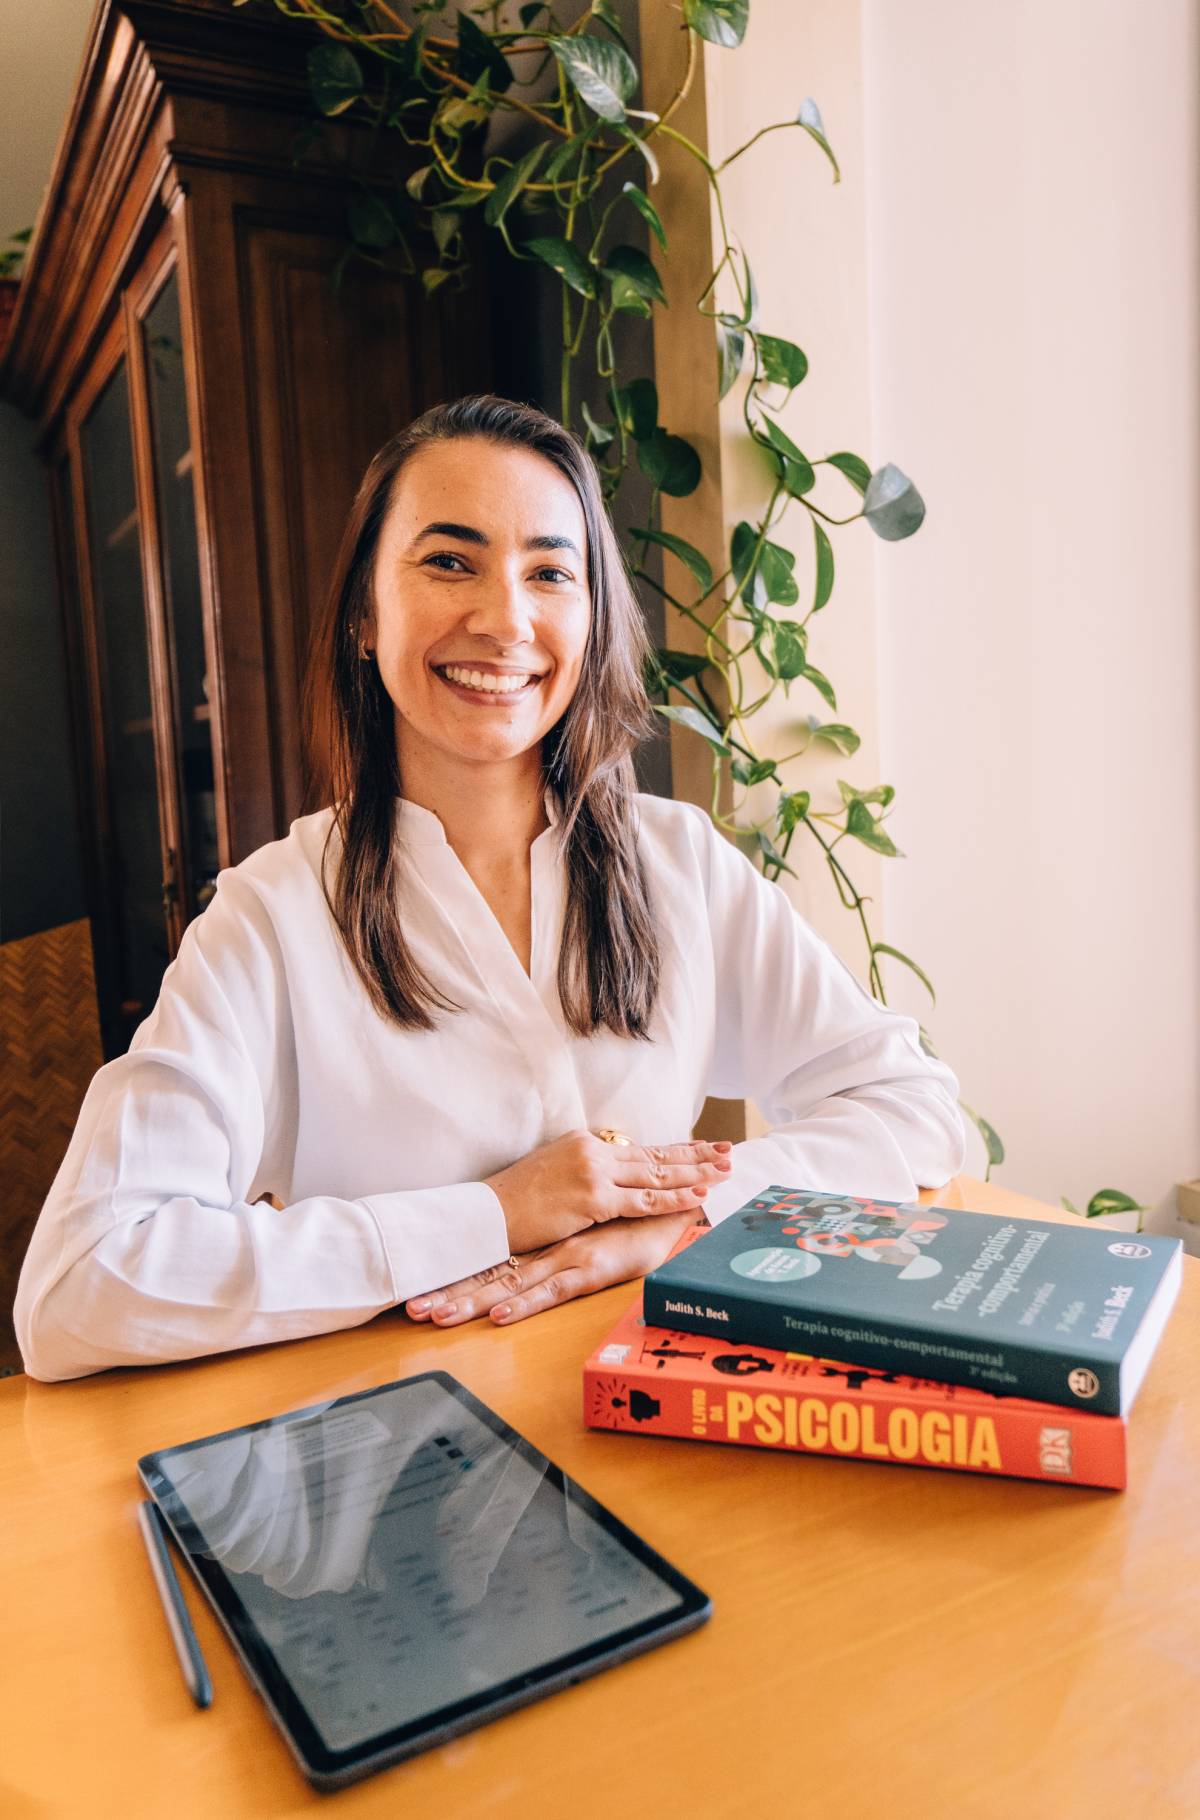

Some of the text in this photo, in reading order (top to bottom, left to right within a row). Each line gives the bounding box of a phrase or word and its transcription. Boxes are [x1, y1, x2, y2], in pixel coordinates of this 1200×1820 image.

[931, 1224, 1017, 1311] Terapia cognitivo-
[978, 1230, 1050, 1317] -comportamental
[665, 1300, 729, 1322] Judith S. Beck
[1104, 1285, 1134, 1309] Beck
[783, 1315, 1004, 1367] Terapia cognitivo-comportamental
[692, 1425, 706, 1435] O
[726, 1391, 1002, 1469] PSICOLOGIA
[1039, 1427, 1073, 1476] DK
